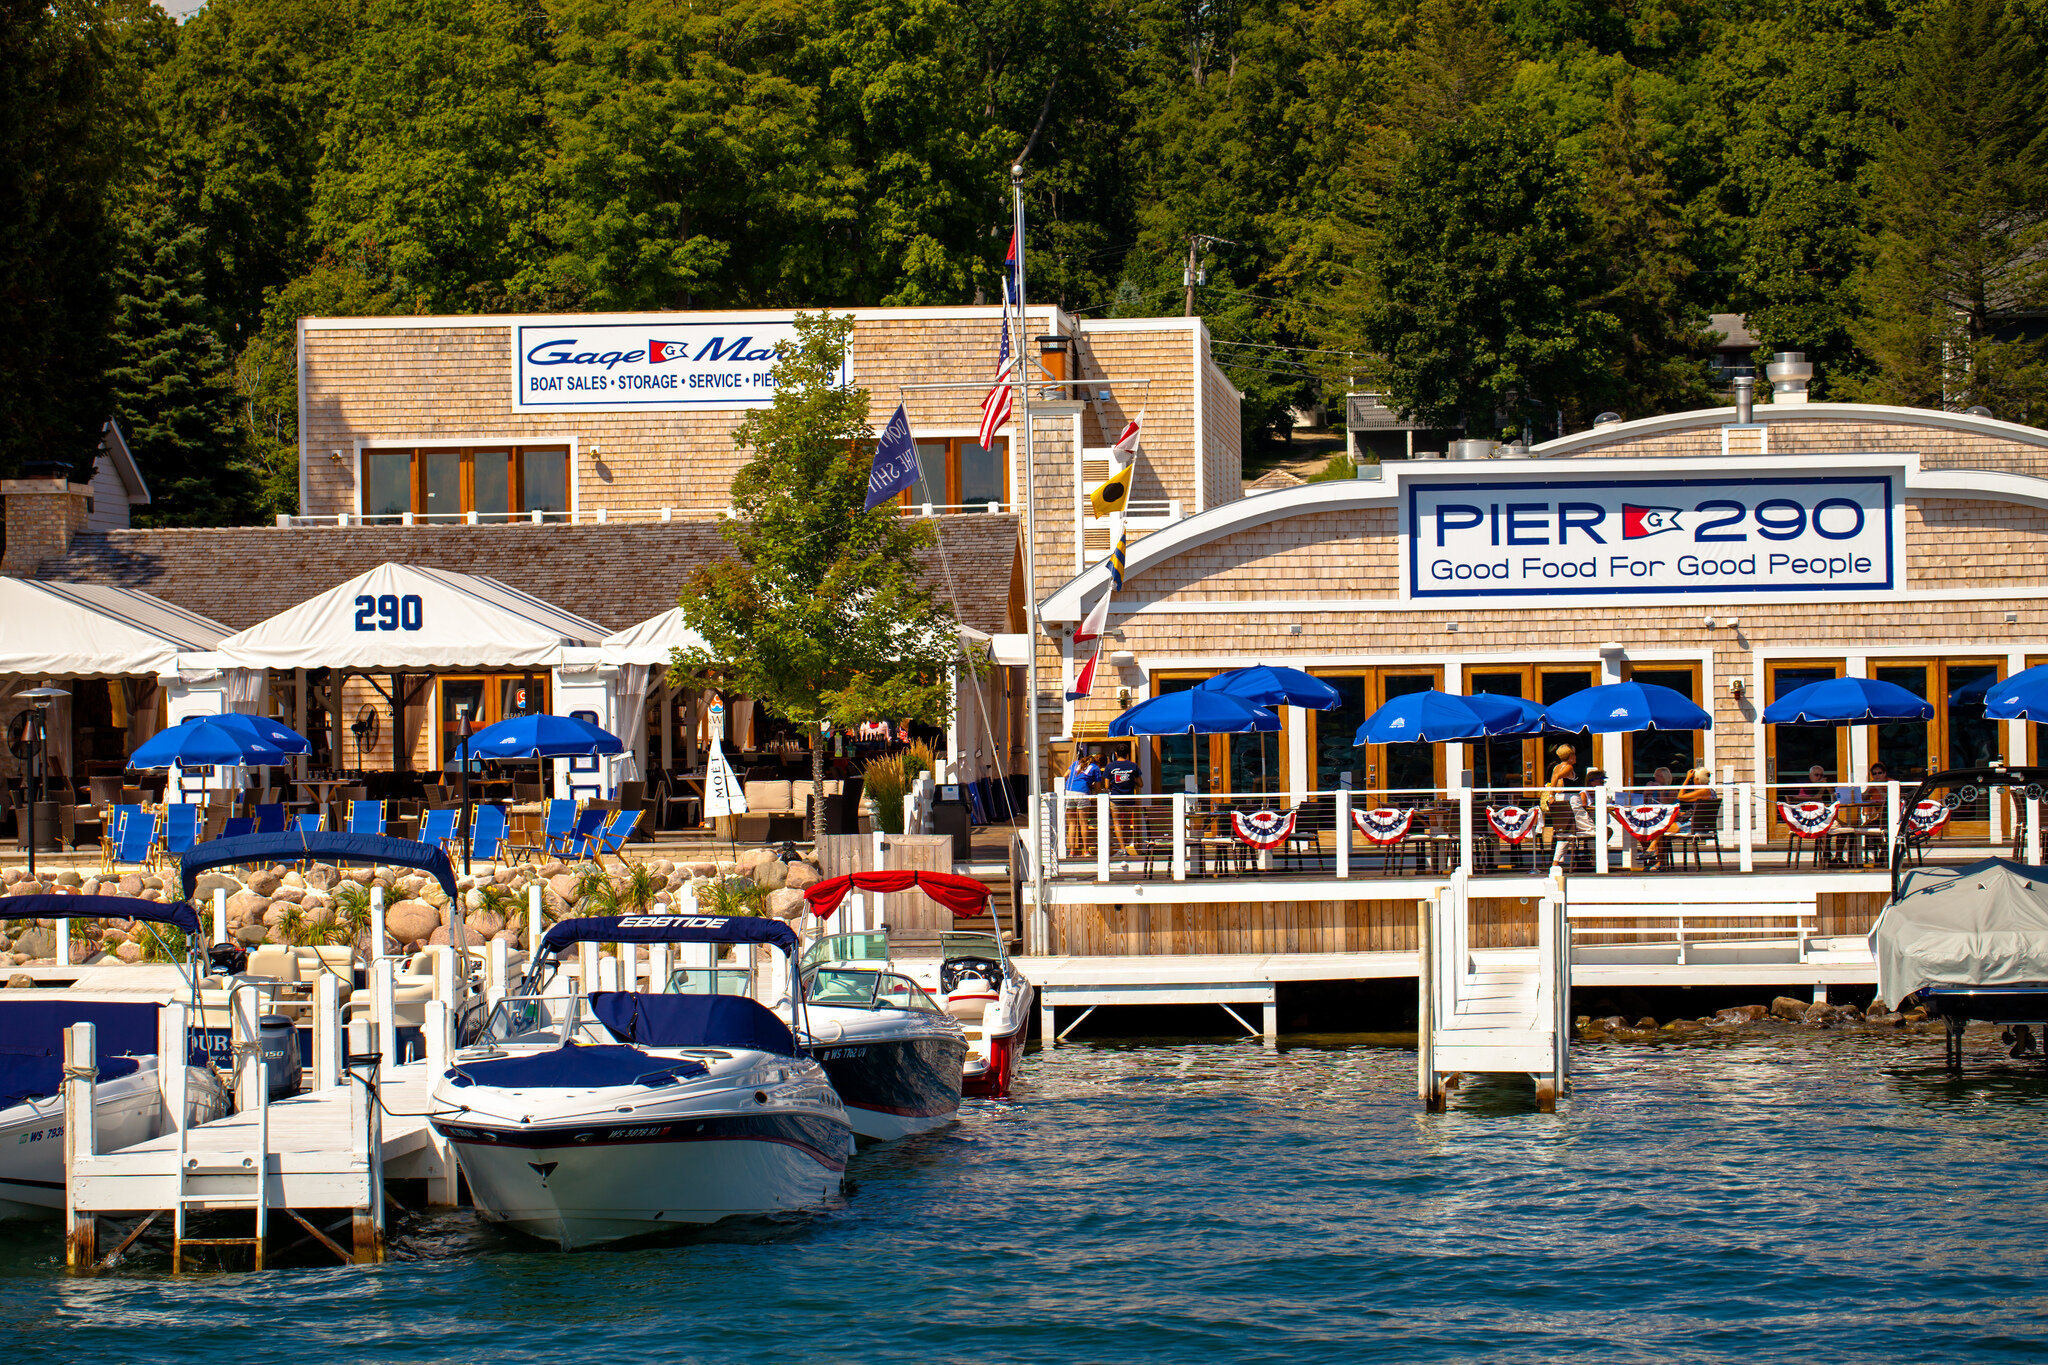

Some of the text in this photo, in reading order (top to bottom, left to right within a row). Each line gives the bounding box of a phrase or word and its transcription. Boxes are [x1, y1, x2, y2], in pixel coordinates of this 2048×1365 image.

[527, 339, 645, 370] Gage
[530, 376, 564, 391] BOAT
[567, 375, 607, 391] SALES
[618, 374, 679, 390] STORAGE
[688, 373, 742, 389] SERVICE
[1436, 502, 1608, 547] PIER
[1694, 497, 1865, 542] 290
[1431, 552, 1872, 580] Good Food For Good People
[354, 594, 423, 632] 290
[617, 916, 729, 929] EBBTIDE
[264, 1050, 285, 1058] 150
[830, 1048, 843, 1060] WS
[29, 1130, 44, 1143] WS
[608, 1129, 626, 1138] WS
